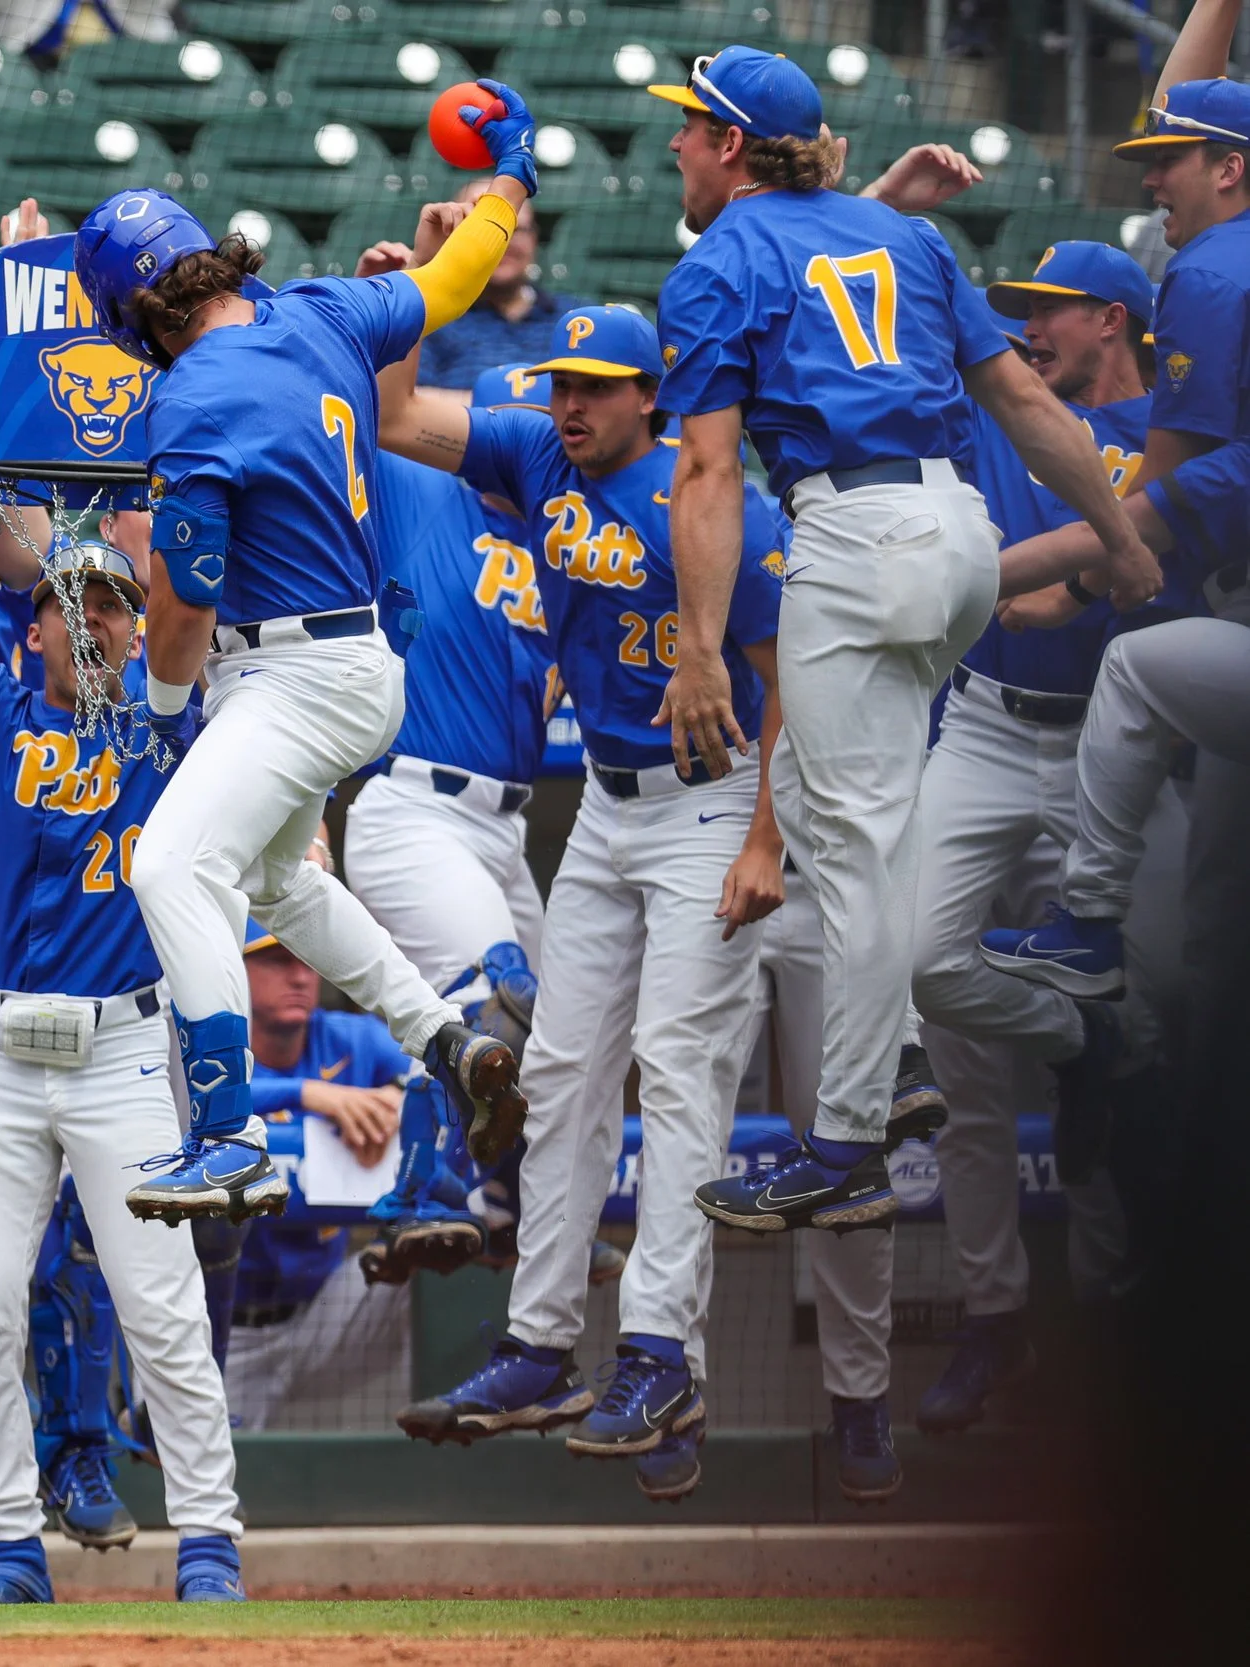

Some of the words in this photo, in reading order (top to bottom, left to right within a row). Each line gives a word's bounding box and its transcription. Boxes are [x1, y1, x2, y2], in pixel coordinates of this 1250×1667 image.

[3, 258, 100, 336] WEN
[135, 254, 153, 274] FF
[566, 316, 595, 349] P
[805, 247, 901, 371] 17
[505, 368, 537, 398] P
[321, 393, 369, 524] 2
[543, 490, 647, 589] Pitt
[473, 532, 549, 637] Pi
[618, 611, 680, 669] 26
[13, 728, 123, 816] Pitt
[890, 1160, 938, 1181] ACC
